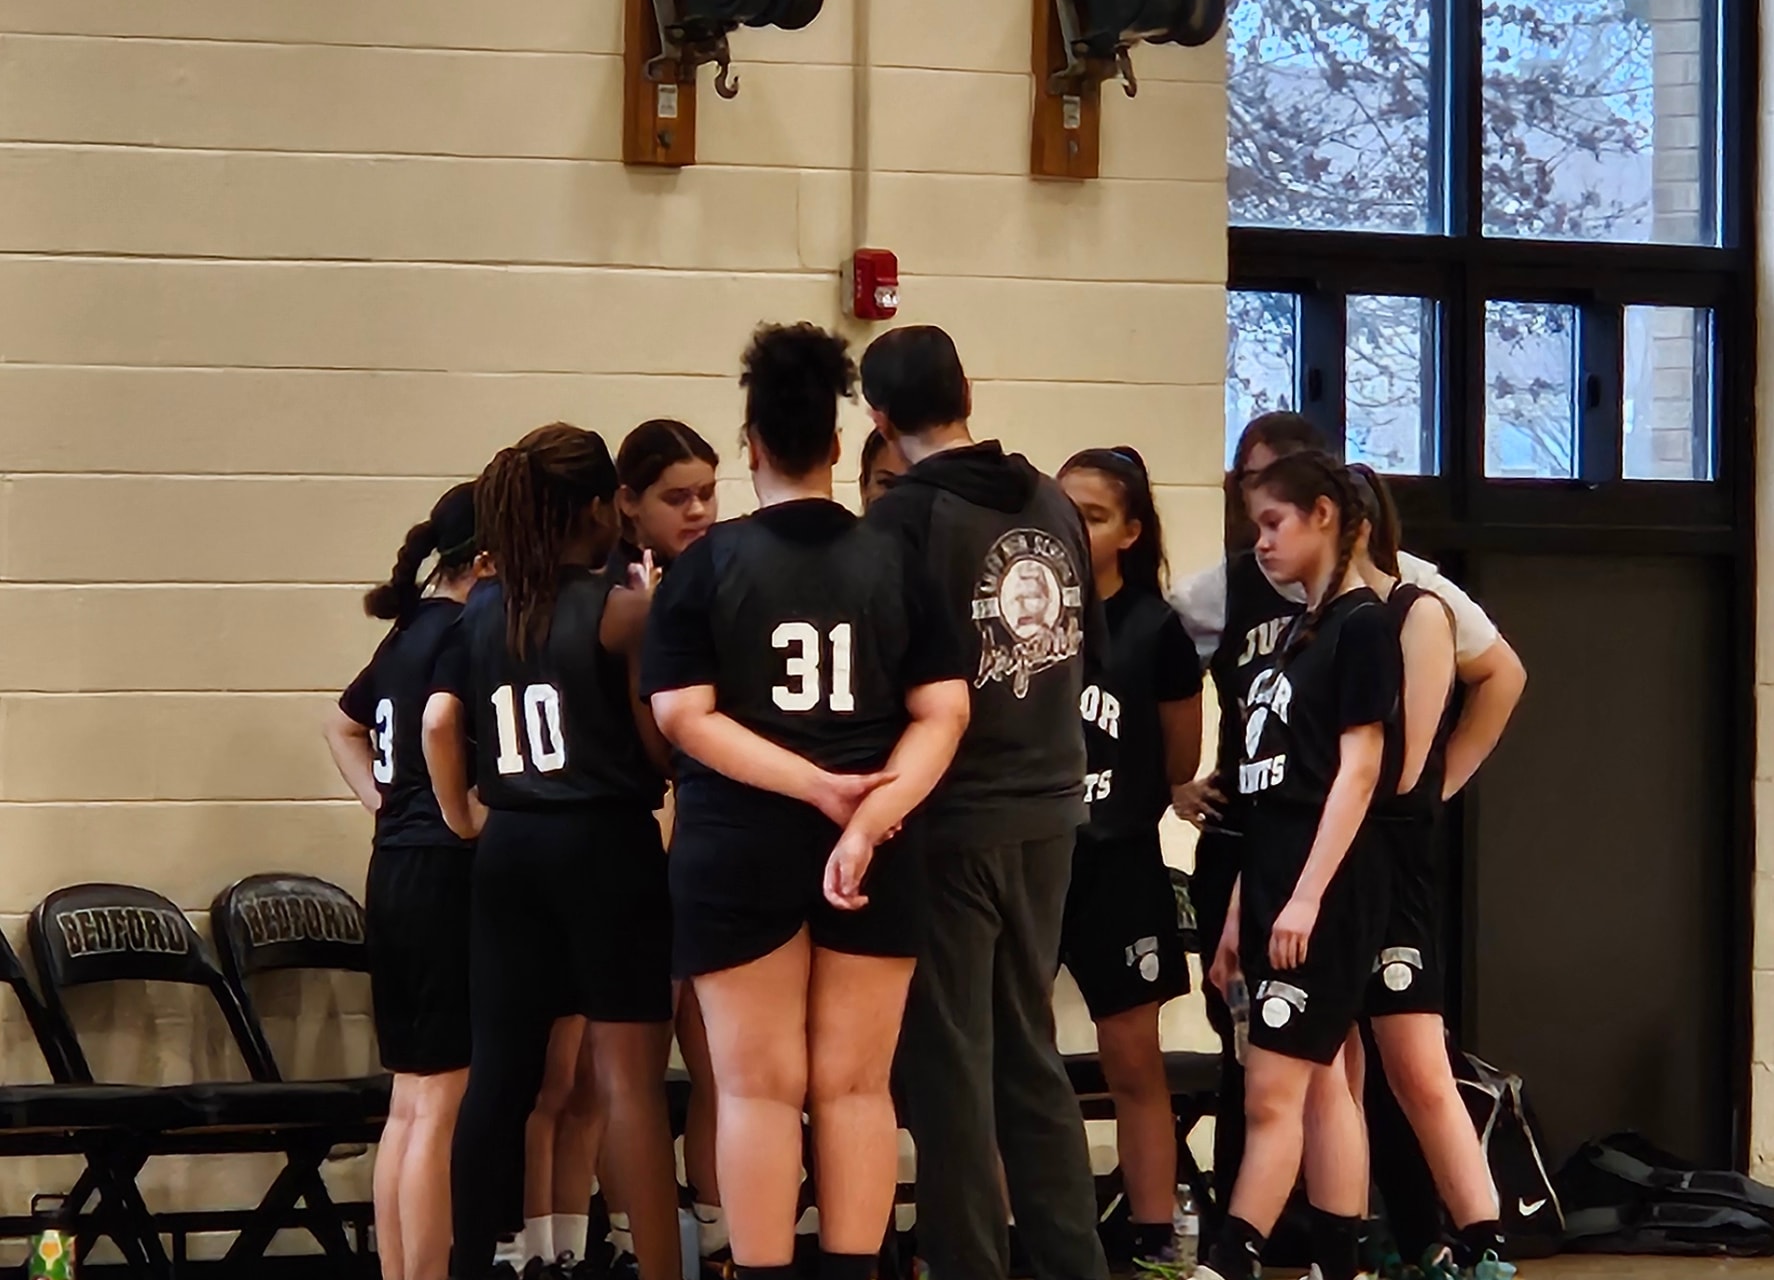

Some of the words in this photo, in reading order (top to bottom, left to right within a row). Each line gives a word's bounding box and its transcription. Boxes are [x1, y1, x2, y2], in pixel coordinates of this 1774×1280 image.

[771, 622, 855, 712] 31
[491, 683, 567, 775] 10
[1079, 684, 1121, 740] OR
[1083, 769, 1113, 804] TS
[56, 906, 189, 958] BEDFORD
[238, 894, 365, 948] BEDFORD
